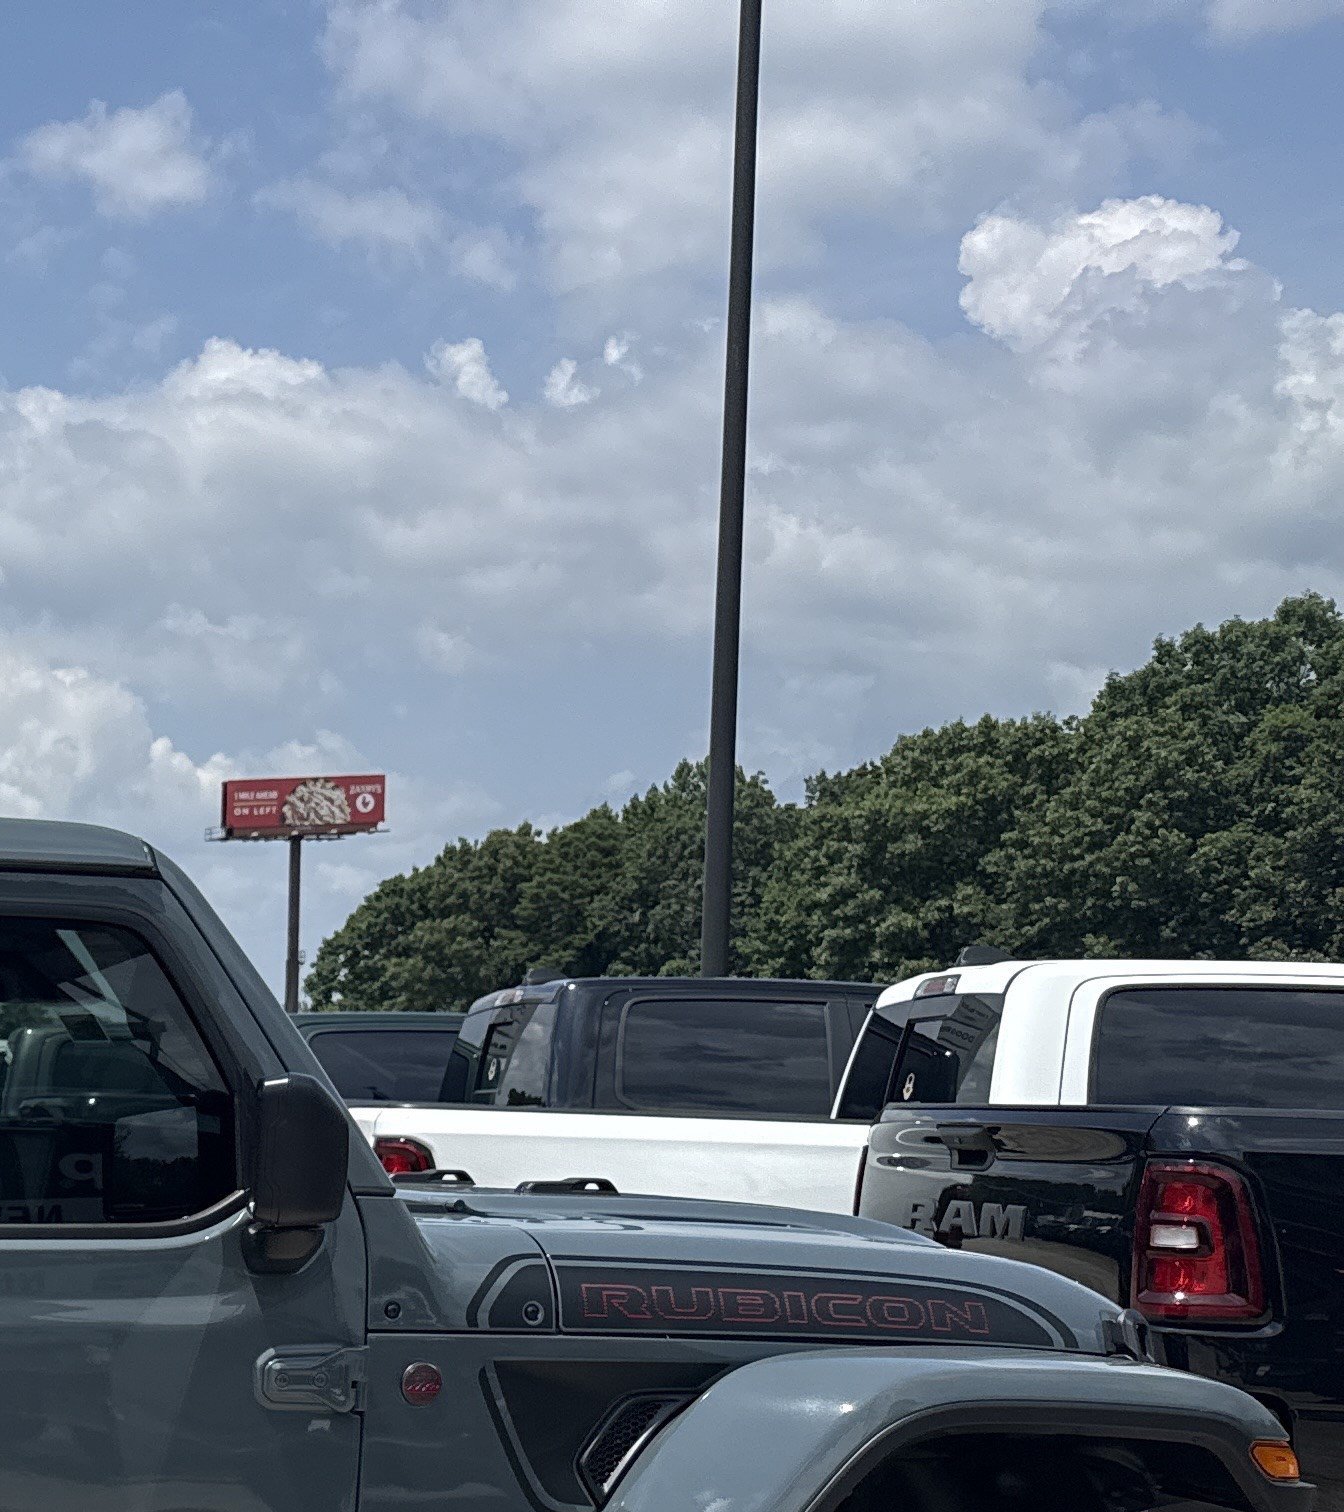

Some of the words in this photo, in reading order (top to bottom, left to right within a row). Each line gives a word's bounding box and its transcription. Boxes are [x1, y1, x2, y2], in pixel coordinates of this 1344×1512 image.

[233, 807, 249, 816] ON
[254, 806, 277, 816] LEFT
[905, 1198, 1028, 1241] RAM
[580, 1282, 991, 1335] RUBICON
